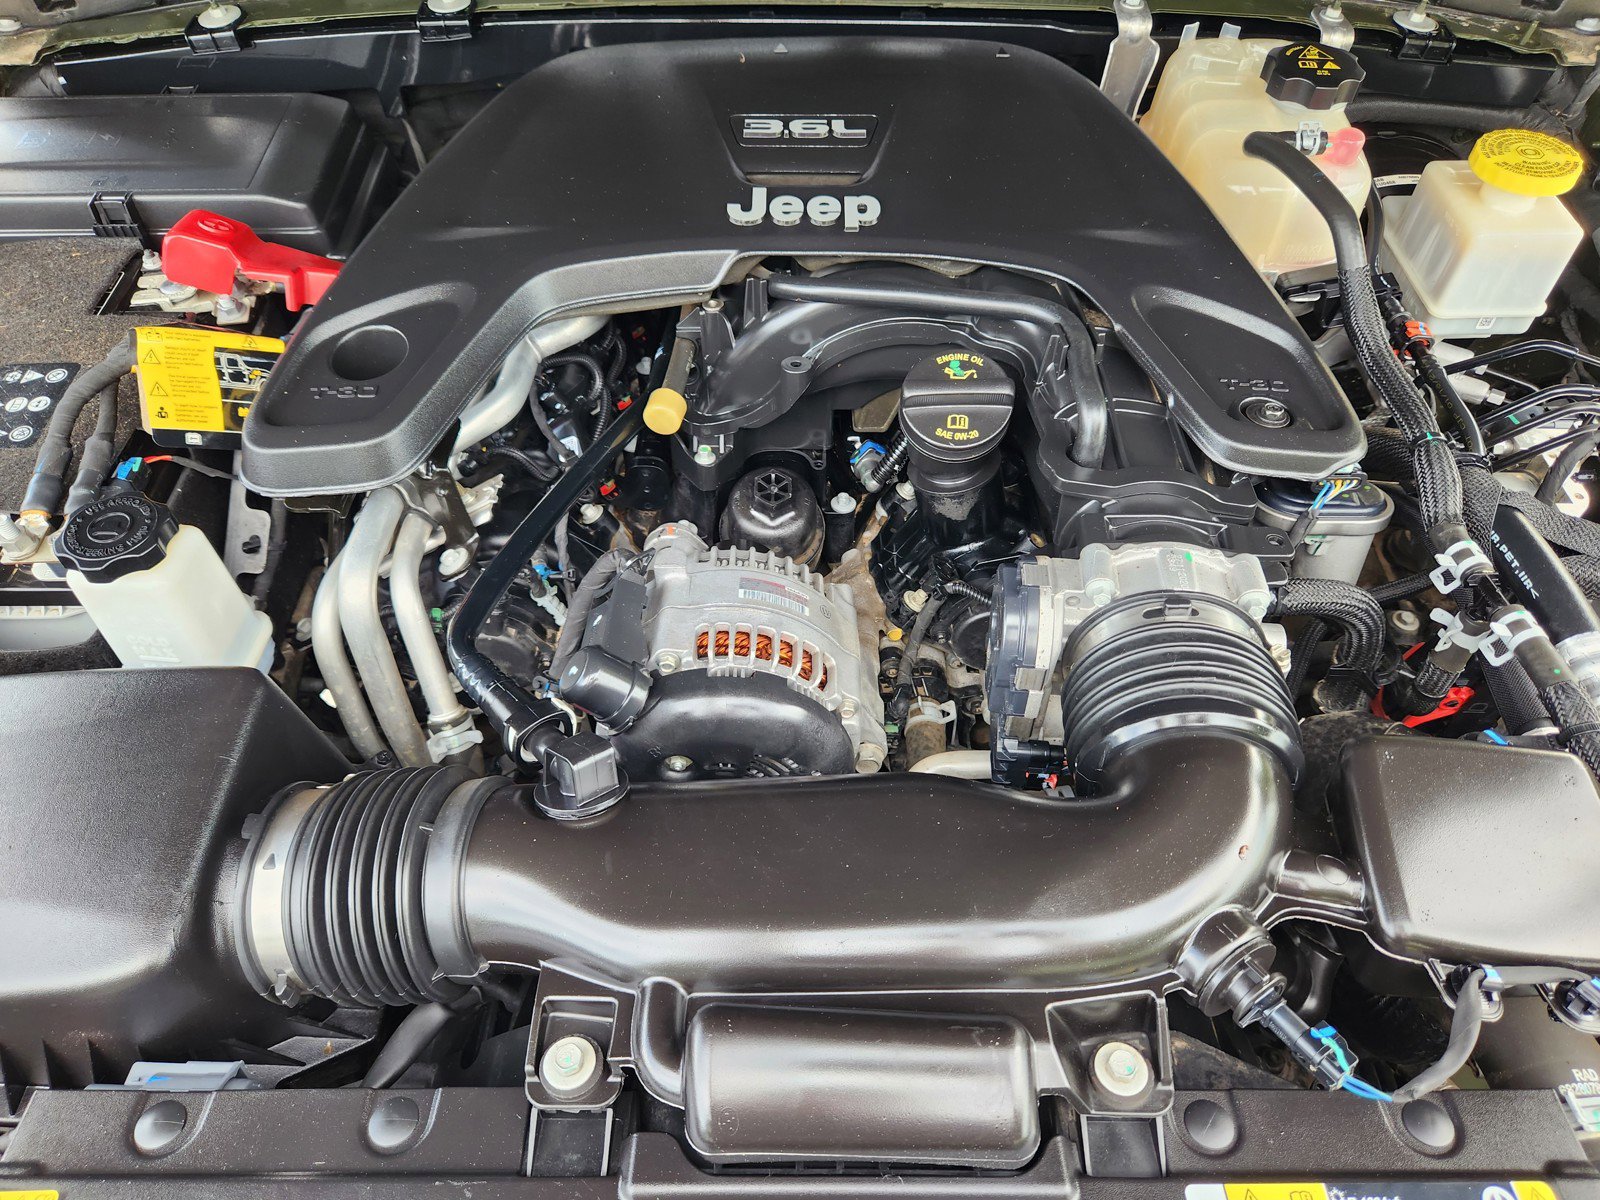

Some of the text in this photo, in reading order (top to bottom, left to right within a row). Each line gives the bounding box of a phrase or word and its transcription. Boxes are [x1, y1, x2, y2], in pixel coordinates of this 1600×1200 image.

[743, 119, 867, 138] 3.6L
[726, 187, 881, 232] Jeep
[936, 353, 984, 367] ENGINE OIL
[935, 427, 979, 440] SAE 0W-20
[85, 502, 105, 516] USE
[1571, 1068, 1599, 1081] RAD
